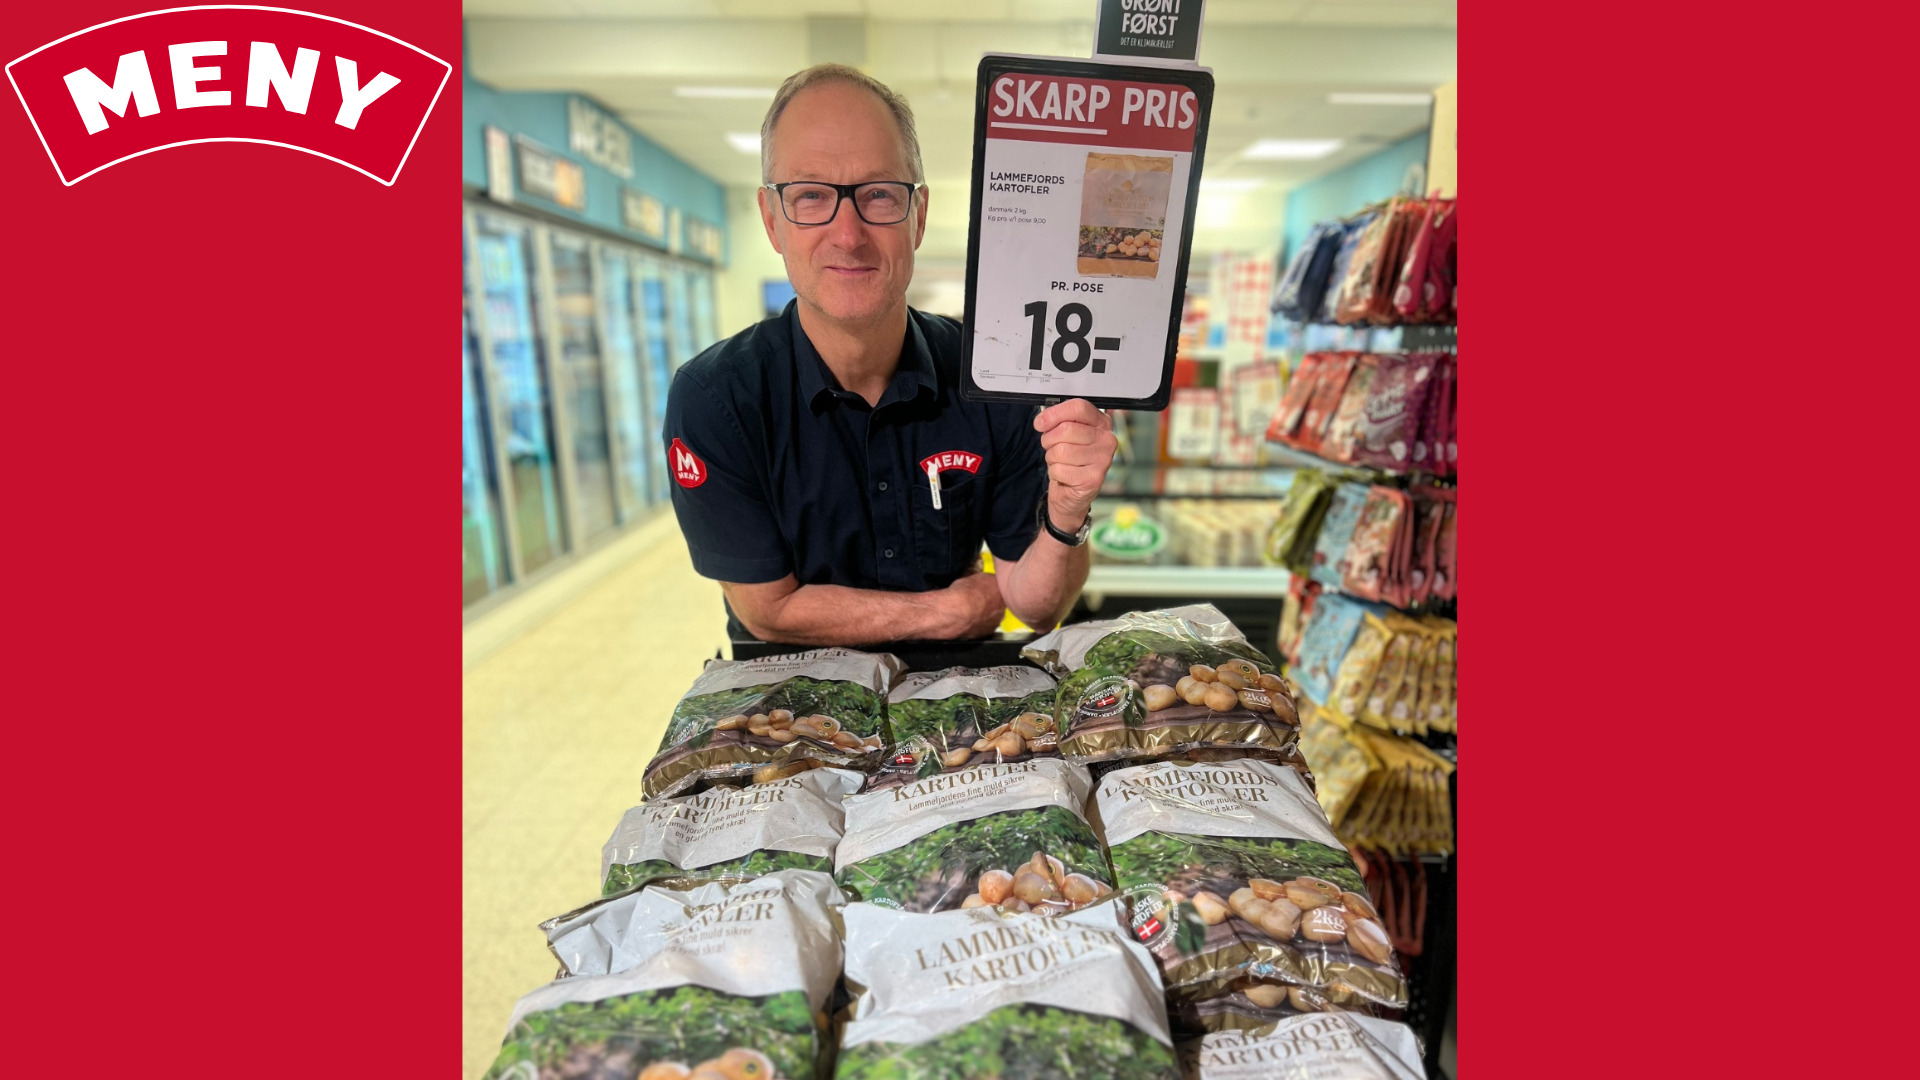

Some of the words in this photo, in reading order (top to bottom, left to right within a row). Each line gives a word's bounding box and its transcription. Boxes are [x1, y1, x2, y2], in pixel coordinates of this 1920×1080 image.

[1121, 12, 1178, 36] FØRST
[1120, 37, 1130, 46] DET
[993, 77, 1111, 123] SKARP
[1121, 87, 1196, 130] PRIS
[990, 171, 1065, 185] LAMMEFJORDS
[989, 182, 1050, 195] KARTOFLER
[988, 205, 1013, 213] danmark
[1050, 280, 1070, 292] PR.
[1072, 282, 1105, 293] POSE
[675, 446, 700, 476] M
[677, 471, 700, 482] MENY
[1243, 691, 1271, 706] 2kg
[893, 762, 1039, 803] KARTOFLER
[1104, 769, 1279, 799] LAMMEFJORDS
[908, 790, 967, 811] Lammefjordens
[966, 786, 982, 797] fine
[983, 780, 1003, 793] muld
[1004, 775, 1026, 787] sikrer
[1312, 907, 1345, 931] 2kg
[700, 927, 724, 942] muld
